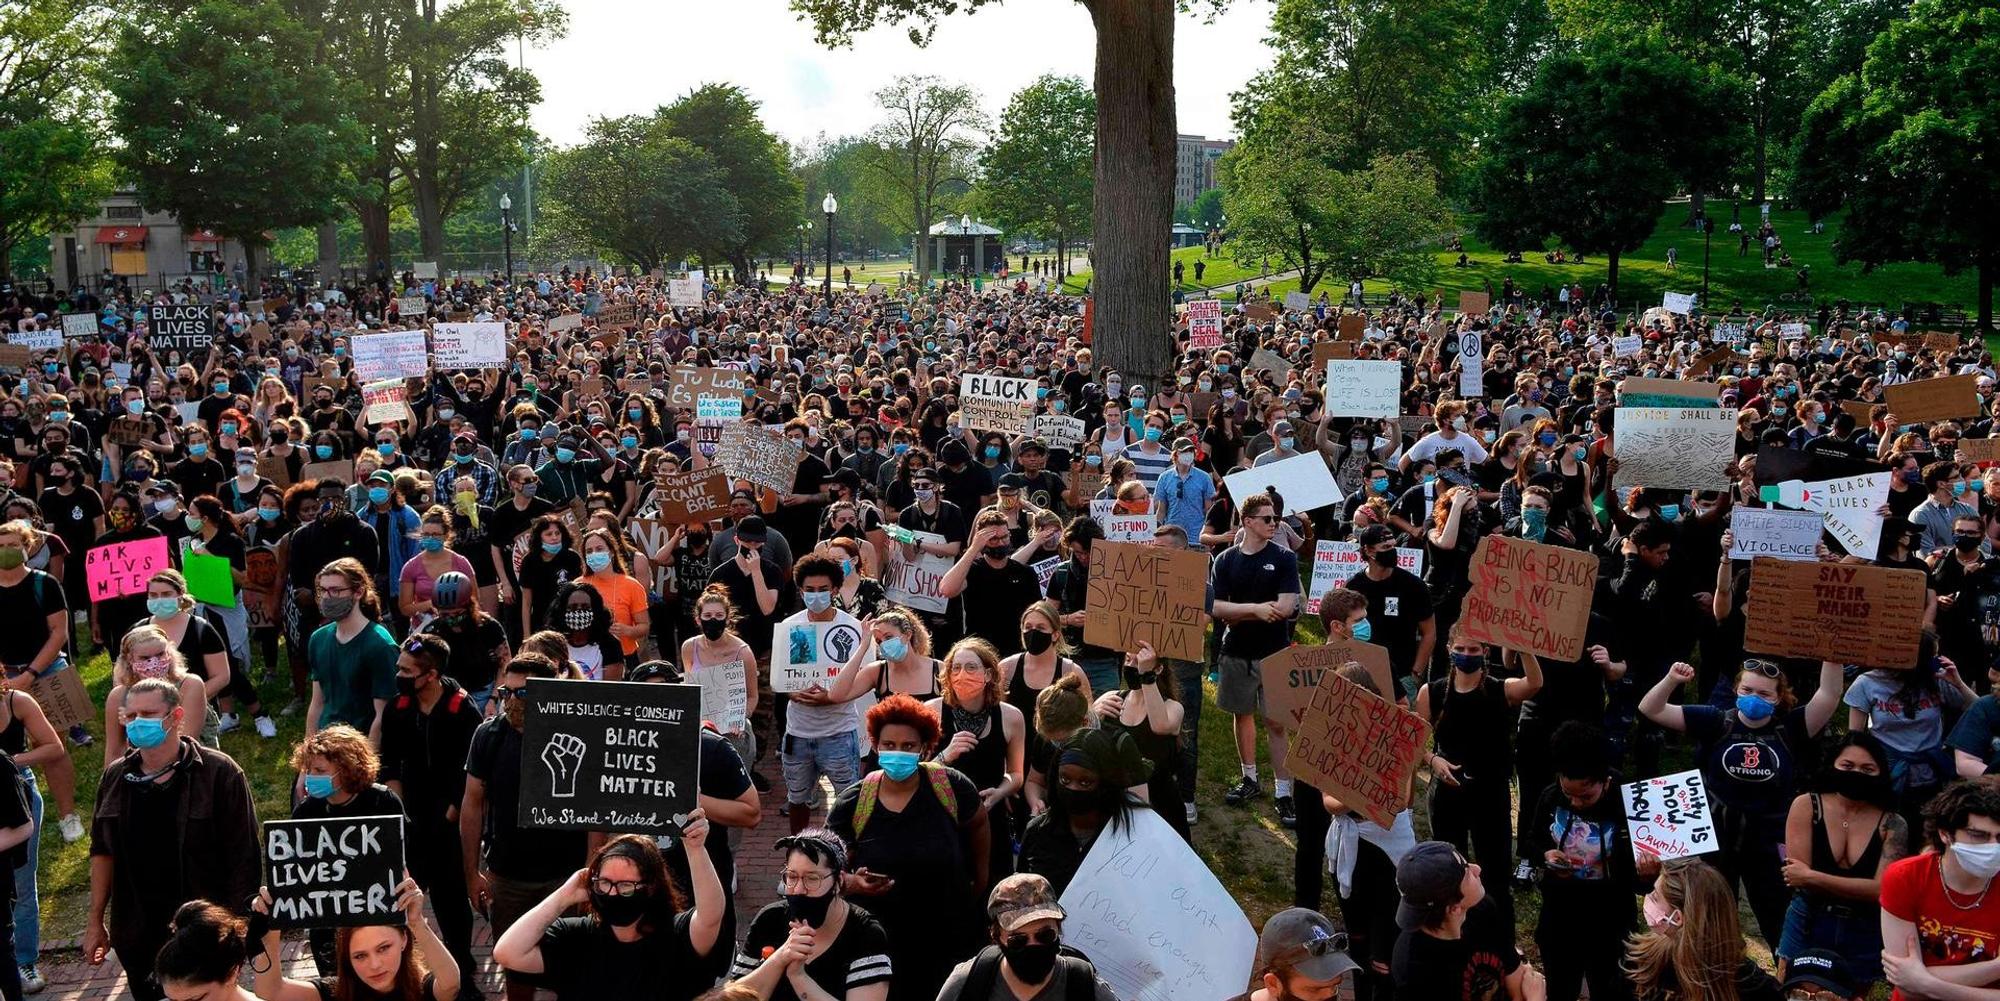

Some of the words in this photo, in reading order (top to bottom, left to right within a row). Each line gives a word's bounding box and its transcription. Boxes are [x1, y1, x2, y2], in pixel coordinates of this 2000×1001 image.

[152, 306, 210, 319] BLACK
[1190, 302, 1218, 310] POLICE
[157, 321, 205, 334] LIVES
[1192, 325, 1219, 335] REAL
[150, 335, 213, 348] MATTER
[675, 369, 703, 385] Tu
[672, 384, 692, 404] Es
[971, 378, 1028, 400] BLACK
[1361, 384, 1370, 397] IS
[964, 396, 1020, 410] COMMUNITY
[963, 406, 1017, 420] CONTROL
[1038, 418, 1064, 426] Defund
[1622, 410, 1669, 420] JUSTICE
[1680, 410, 1711, 419] SHALL
[1720, 411, 1733, 420] BE
[967, 418, 985, 427] THE
[989, 420, 1026, 433] POLICE
[743, 457, 774, 475] NAMES
[654, 476, 664, 485] I
[1829, 477, 1875, 494] BLACK
[658, 490, 671, 501] I
[1829, 498, 1868, 508] LIVES
[1111, 521, 1148, 532] DEFUND
[1737, 516, 1775, 528] WHITE
[1780, 517, 1820, 531] SILENCE
[1823, 511, 1864, 549] MATTER
[1766, 531, 1782, 539] IS
[88, 546, 127, 564] BAK
[1317, 542, 1334, 550] HOW
[1337, 543, 1354, 551] CAN
[1484, 539, 1535, 572] BEING
[1738, 539, 1813, 555] VIOLENCE
[110, 556, 152, 575] LVS
[1317, 551, 1334, 561] THE
[1336, 553, 1359, 562] LAND
[1090, 546, 1170, 587] BLAME
[1545, 554, 1597, 591] BLACK
[1818, 565, 1858, 583] SAY
[1176, 576, 1195, 592] THE
[1812, 584, 1865, 601] THEIR
[1088, 577, 1168, 620] SYSTEM
[1494, 576, 1512, 597] IS
[1529, 585, 1568, 611] NOT
[1170, 603, 1204, 625] NOT
[1467, 597, 1541, 633] PROBABLE
[1816, 599, 1872, 618] NAMES
[1090, 611, 1108, 625] THE
[1118, 616, 1188, 657] VICTIM
[1531, 627, 1577, 658] CAUSE
[1293, 648, 1352, 667] WHITE
[784, 668, 806, 678] This
[812, 670, 820, 678] is
[537, 701, 575, 715] WHITE
[576, 703, 621, 717] SILENCE
[635, 705, 685, 720] CONSENT
[1318, 671, 1363, 705] LOVE
[1369, 699, 1424, 747] BLACK
[1310, 691, 1360, 731] LIVES
[1367, 723, 1404, 758] LIKE
[605, 727, 659, 748] BLACK
[1323, 720, 1357, 755] YOU
[1358, 748, 1401, 780] LOVE
[1741, 746, 1760, 768] B
[604, 751, 656, 773] LIVES
[1729, 766, 1771, 775] STRONG
[1296, 737, 1342, 782] BLACK
[1341, 766, 1405, 816] CULTURE
[600, 775, 676, 798] MATTER
[1627, 782, 1650, 821] they
[1663, 784, 1686, 824] how
[1678, 790, 1691, 811] BLM
[1683, 776, 1706, 819] Unity
[532, 807, 557, 825] We
[560, 808, 602, 824] Stand
[1653, 814, 1677, 832] BLM
[268, 824, 382, 860] BLACK
[1691, 826, 1710, 843] is
[272, 860, 347, 887] LIVES
[272, 868, 398, 920] MATTER!
[1079, 890, 1135, 934] Mad
[1074, 923, 1108, 946] For
